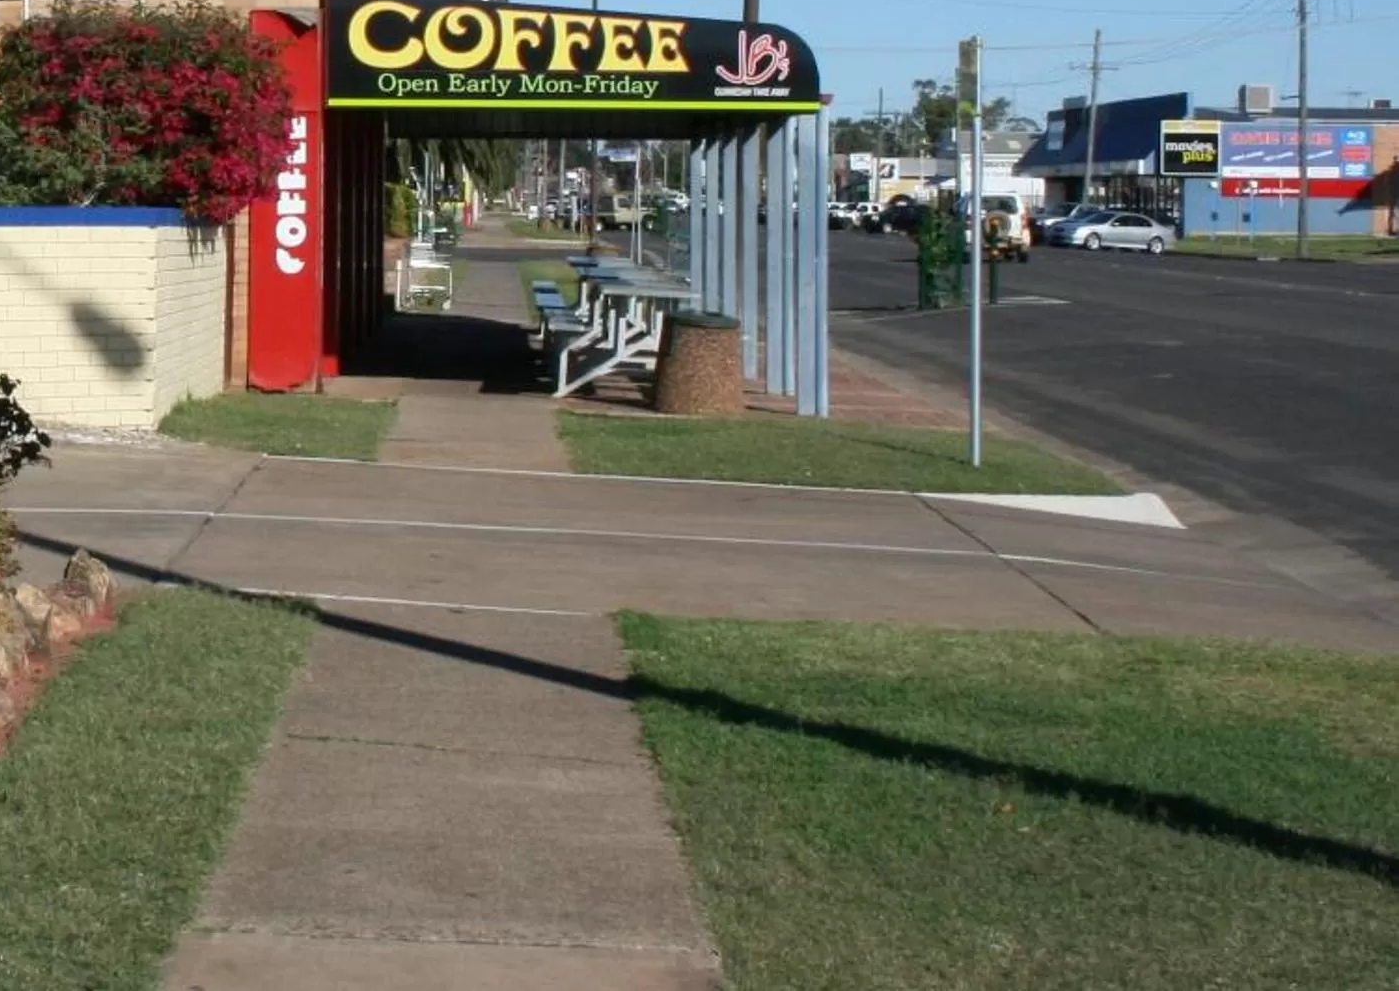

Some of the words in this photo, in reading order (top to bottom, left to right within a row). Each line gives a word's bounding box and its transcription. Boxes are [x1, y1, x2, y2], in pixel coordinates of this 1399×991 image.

[348, 0, 690, 73] COFFEE
[377, 72, 440, 97] Open
[448, 73, 511, 97] Early
[518, 74, 660, 98] Mon-Friday
